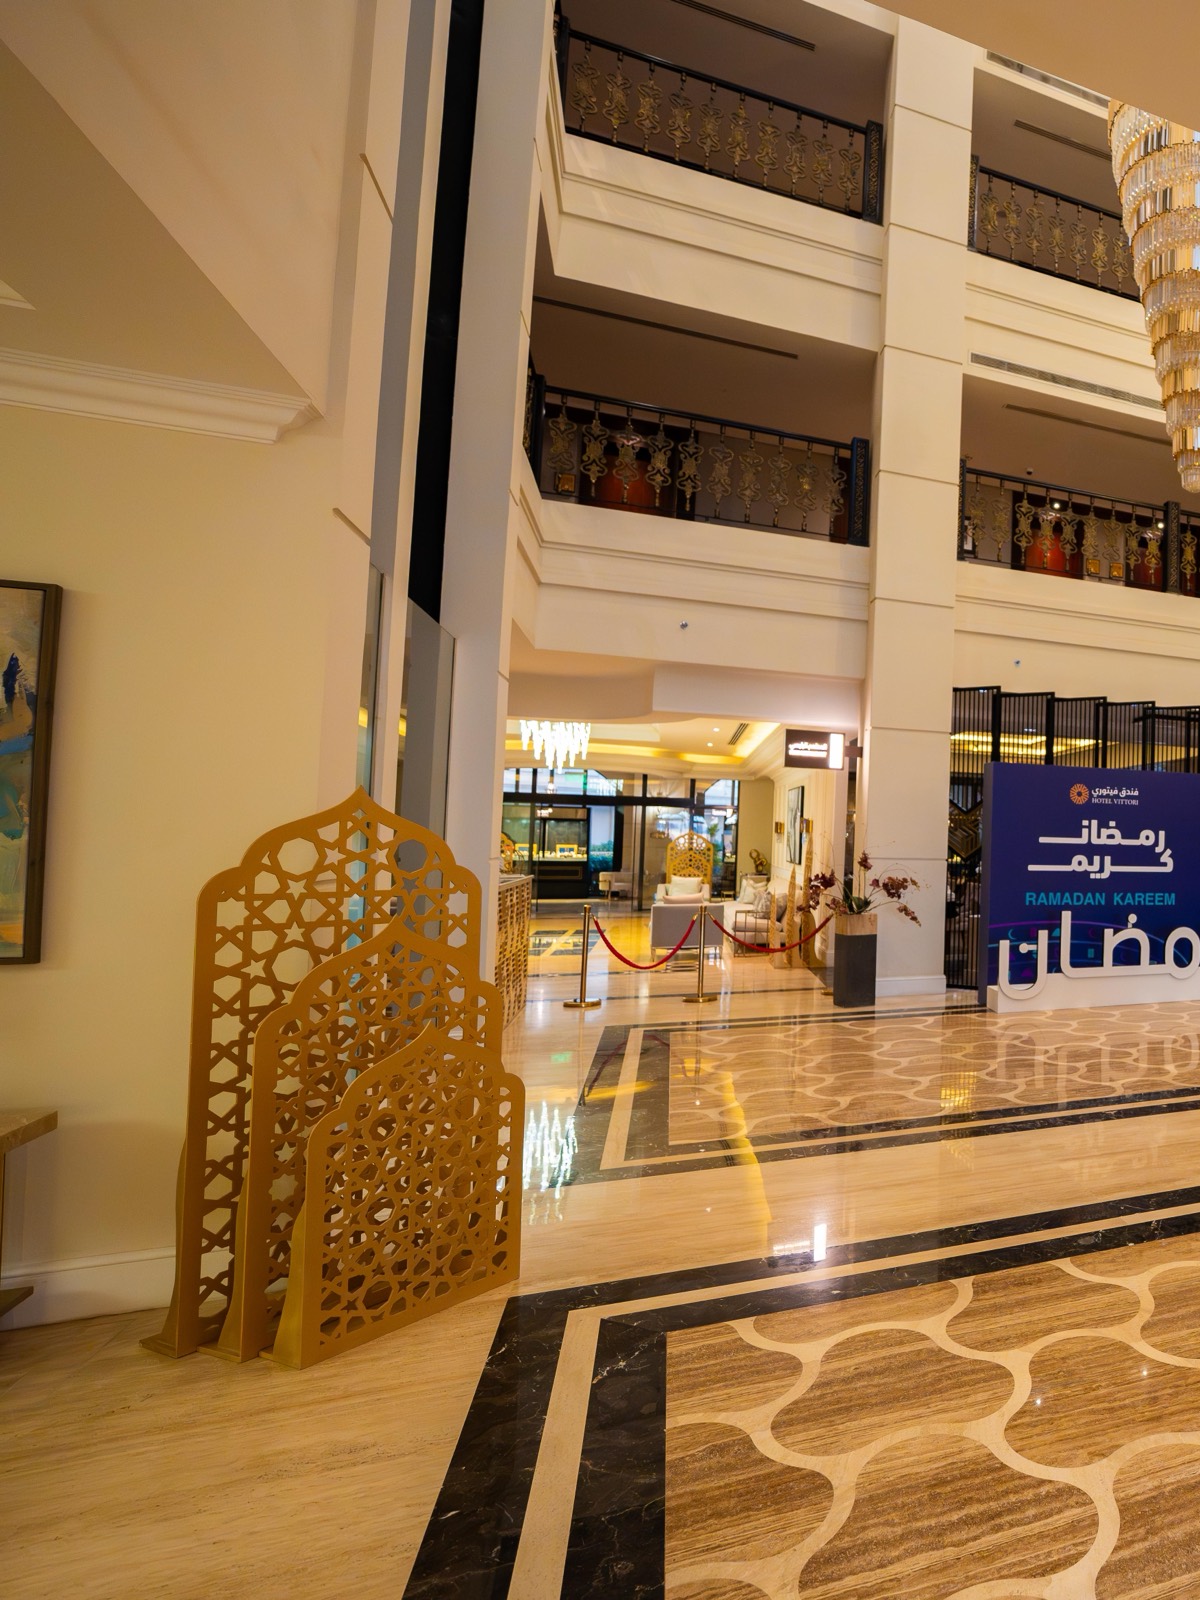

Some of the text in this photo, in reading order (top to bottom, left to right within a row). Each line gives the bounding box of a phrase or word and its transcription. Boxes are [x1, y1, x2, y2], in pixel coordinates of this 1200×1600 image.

[1092, 786, 1139, 797] فندق فيتوري
[1025, 892, 1175, 906] RAMADAN KAREEM
